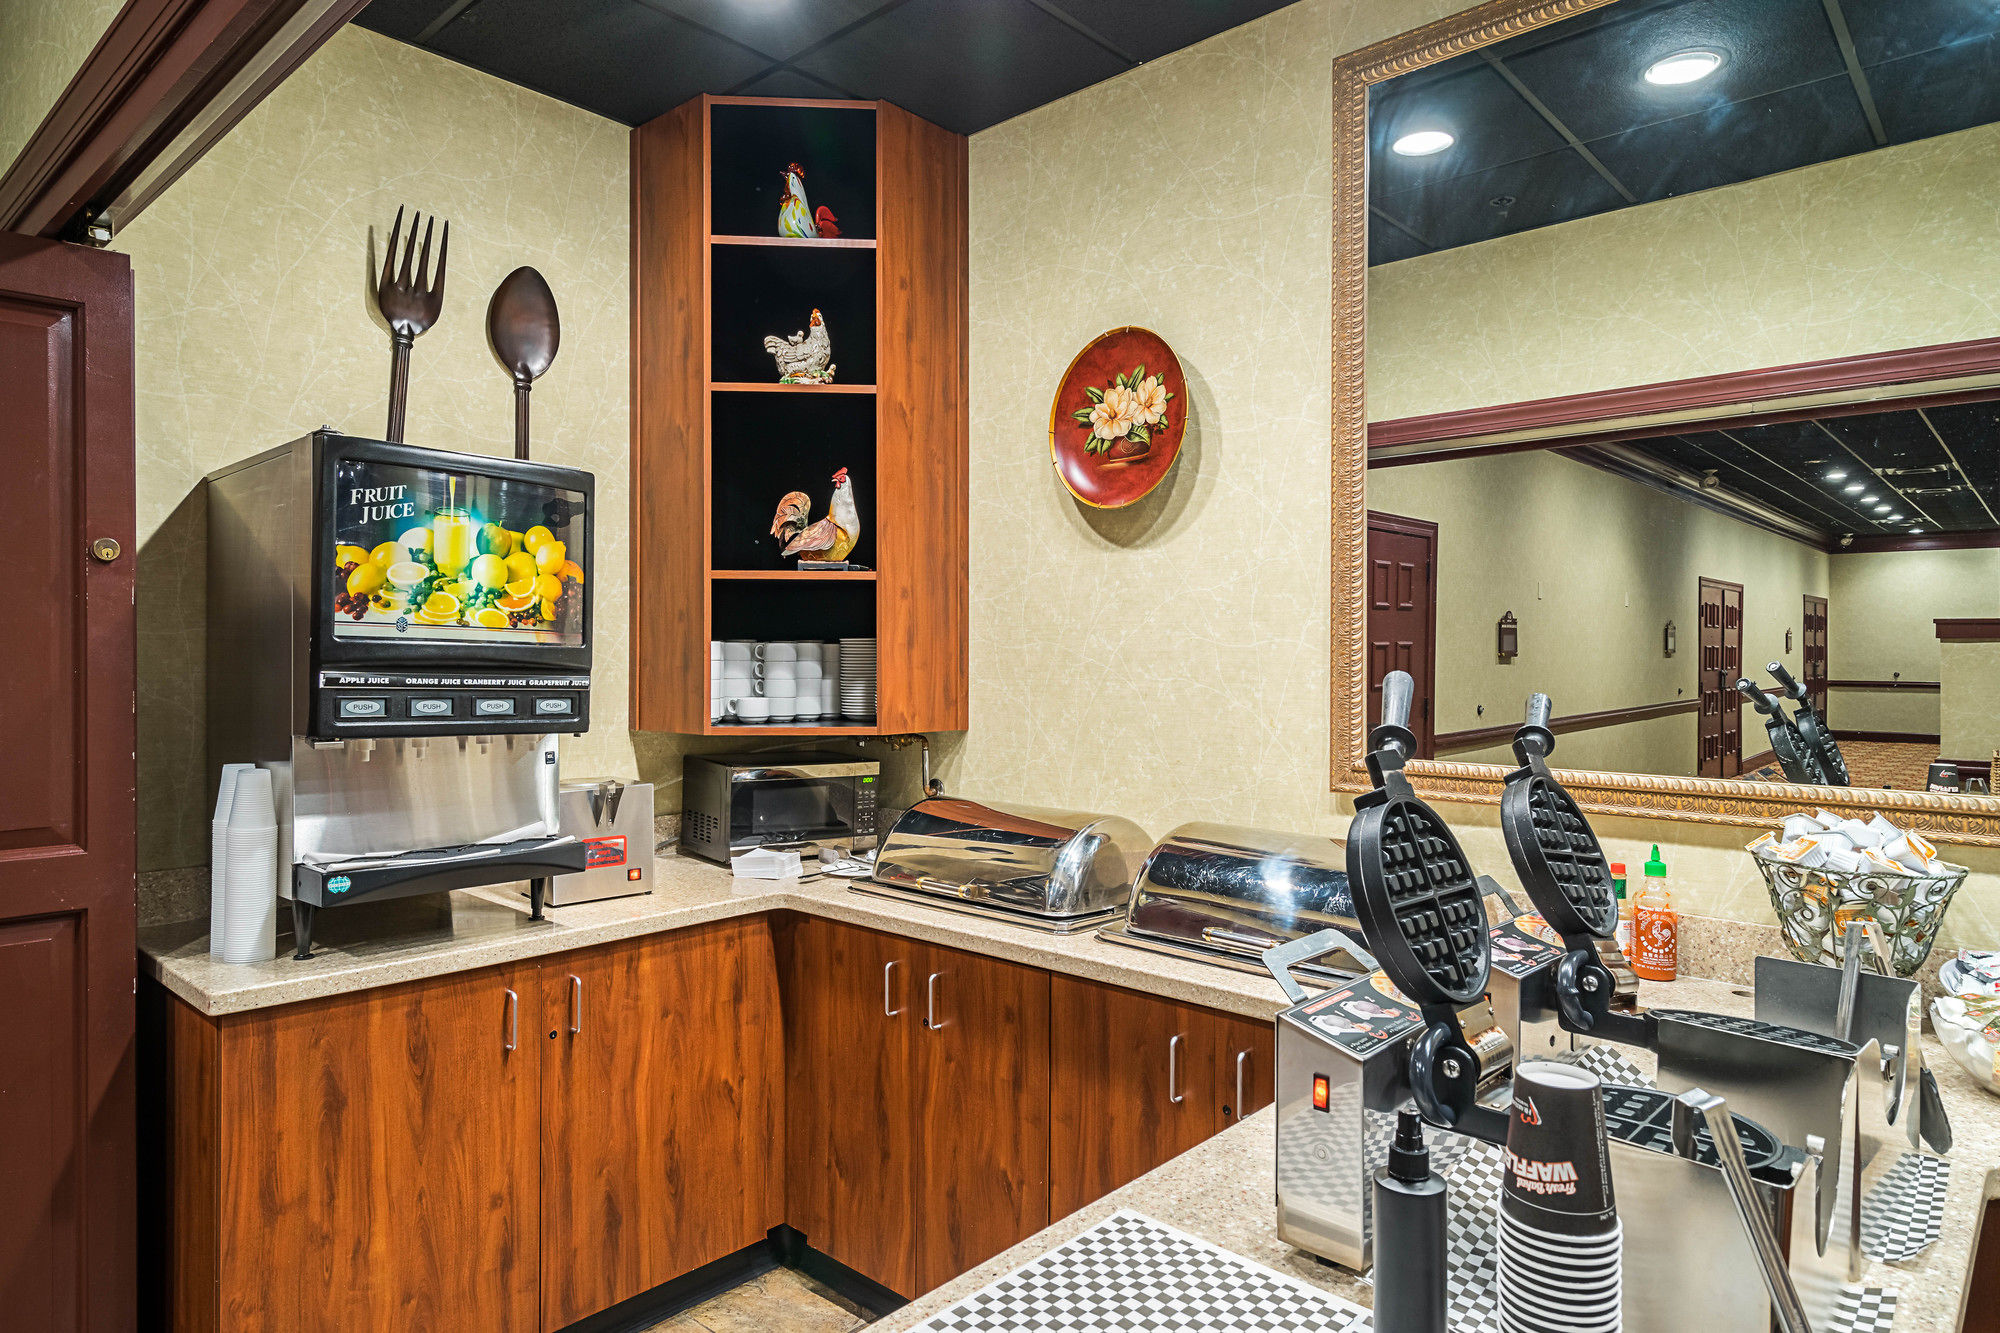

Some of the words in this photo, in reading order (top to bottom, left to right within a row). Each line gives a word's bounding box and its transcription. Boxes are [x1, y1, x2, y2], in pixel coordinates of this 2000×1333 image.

[350, 484, 407, 505] FRUIT
[359, 502, 415, 525] JUICE
[405, 677, 439, 685] ORANGE
[463, 678, 506, 686] CRANBERRY
[507, 678, 527, 686] JUICE
[353, 702, 373, 710] PUSH
[422, 701, 441, 710] PUSH
[486, 701, 504, 710] PUSH
[545, 700, 562, 708] PUSH
[1516, 1176, 1545, 1195] Baked
[1545, 1181, 1577, 1196] Fresh
